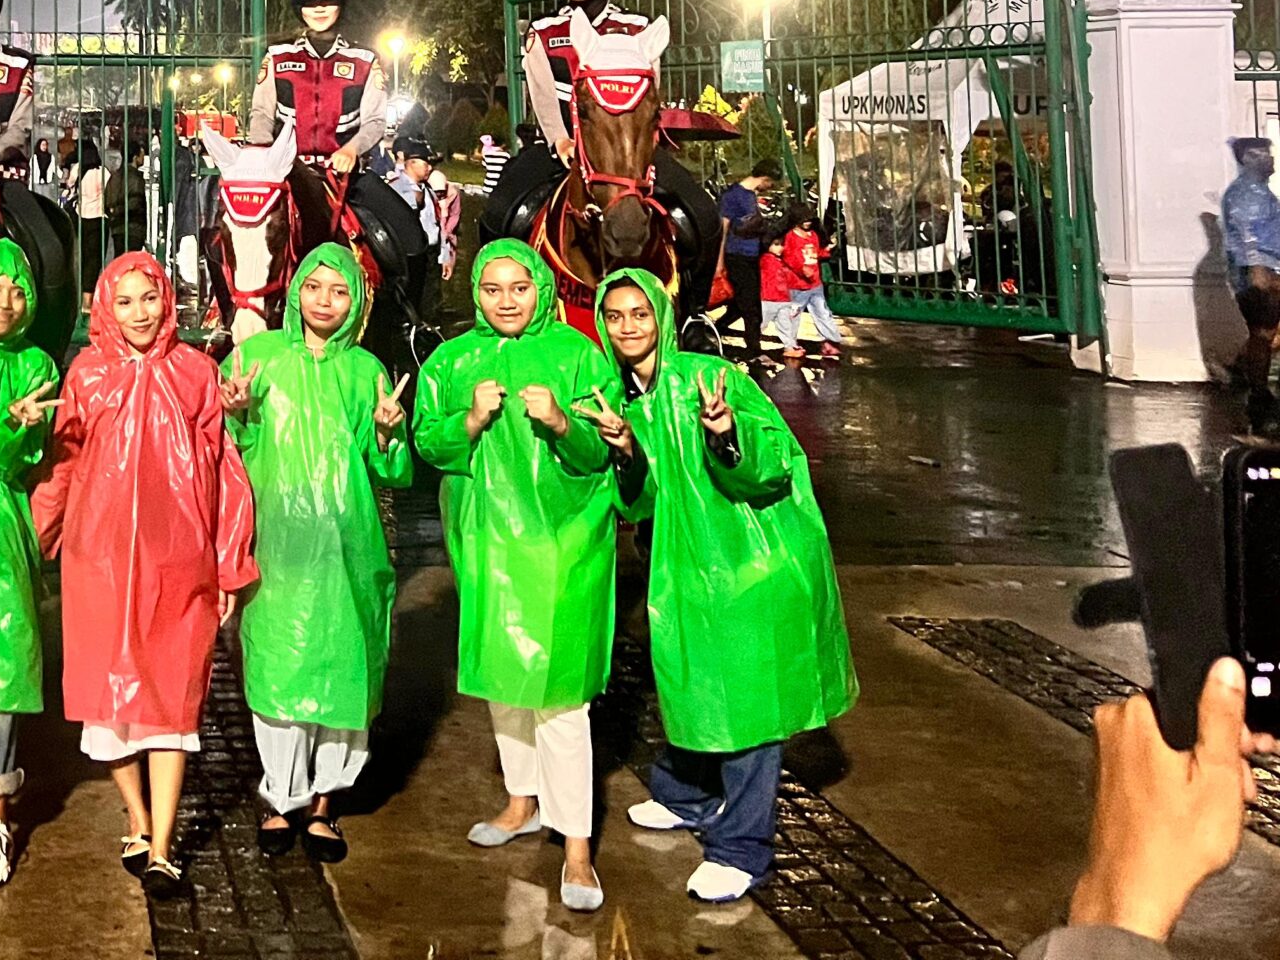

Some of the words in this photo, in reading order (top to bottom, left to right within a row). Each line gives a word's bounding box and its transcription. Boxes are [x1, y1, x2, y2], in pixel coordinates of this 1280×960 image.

[599, 82, 635, 94] POLRI
[842, 95, 868, 114] UPK
[871, 94, 926, 114] MONAS
[1014, 95, 1048, 116] UP
[233, 193, 265, 205] POLRI
